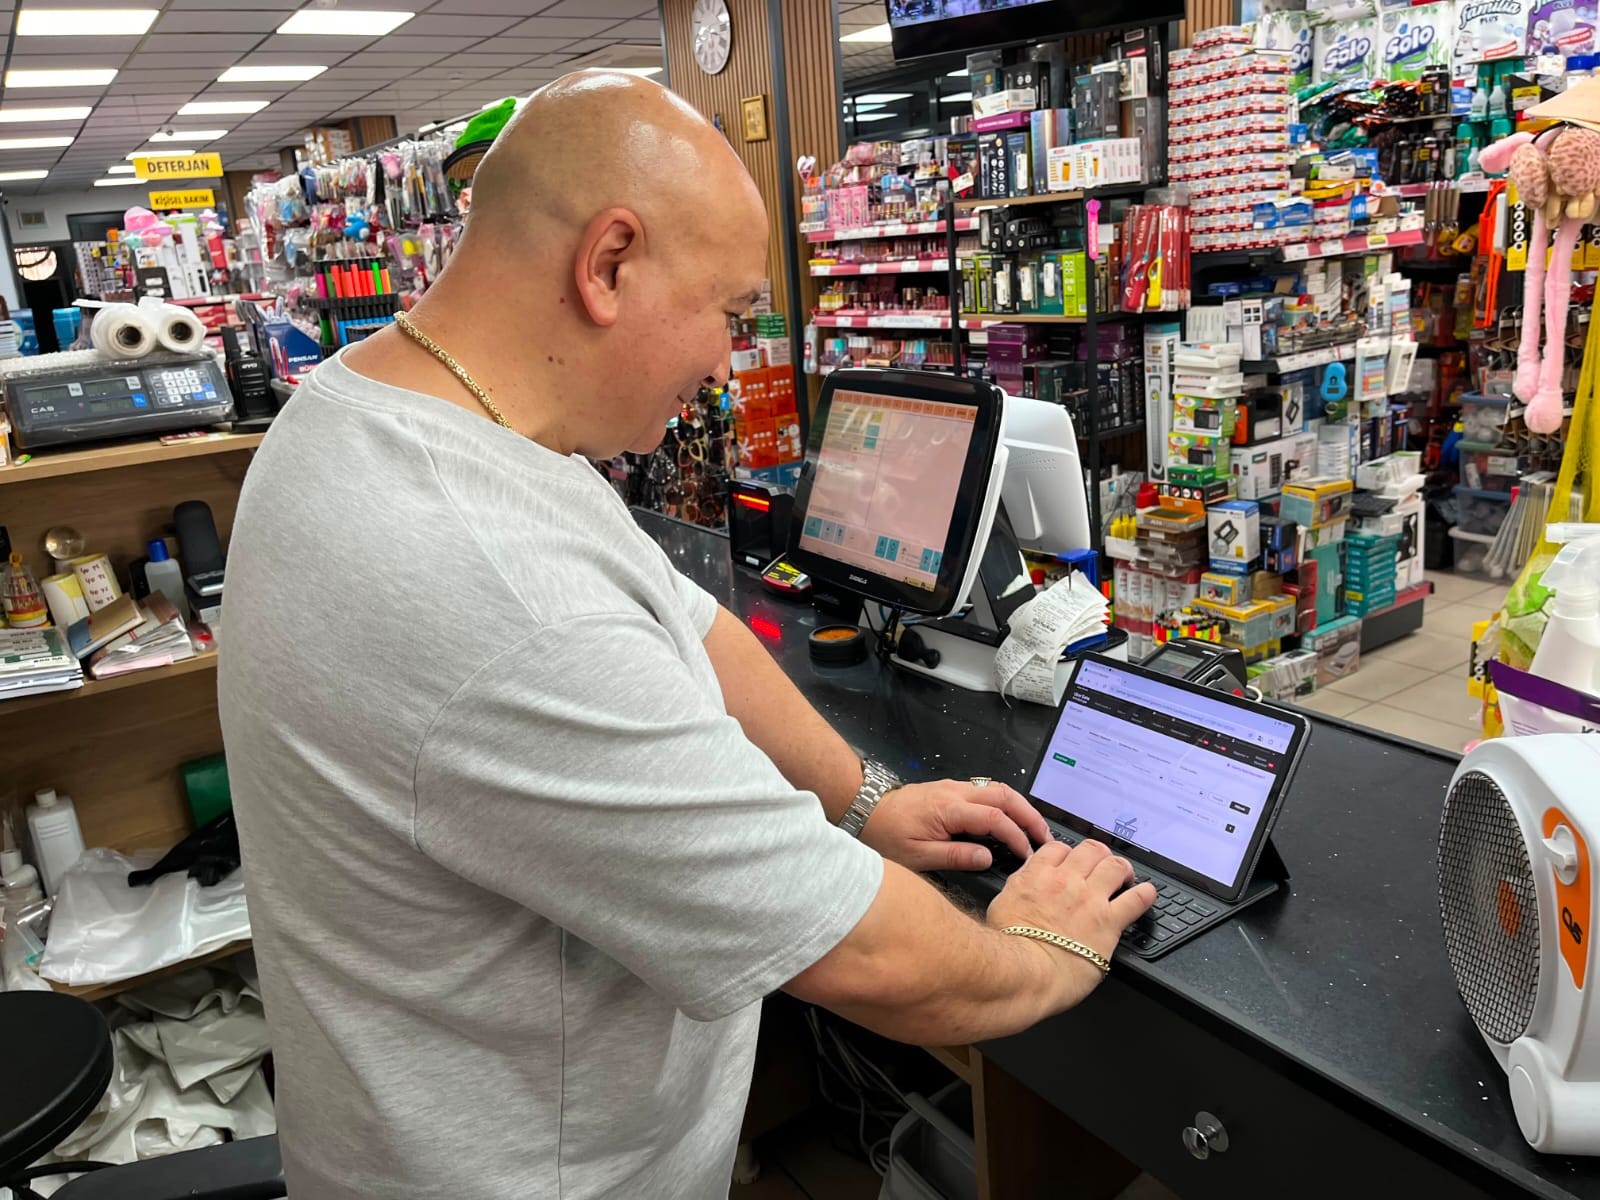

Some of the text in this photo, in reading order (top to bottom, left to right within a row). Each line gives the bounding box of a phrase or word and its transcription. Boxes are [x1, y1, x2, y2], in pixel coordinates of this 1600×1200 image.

[1291, 43, 1312, 70] So
[1326, 37, 1371, 70] Solo
[1386, 25, 1435, 62] Solo
[147, 159, 210, 174] DETERJAN
